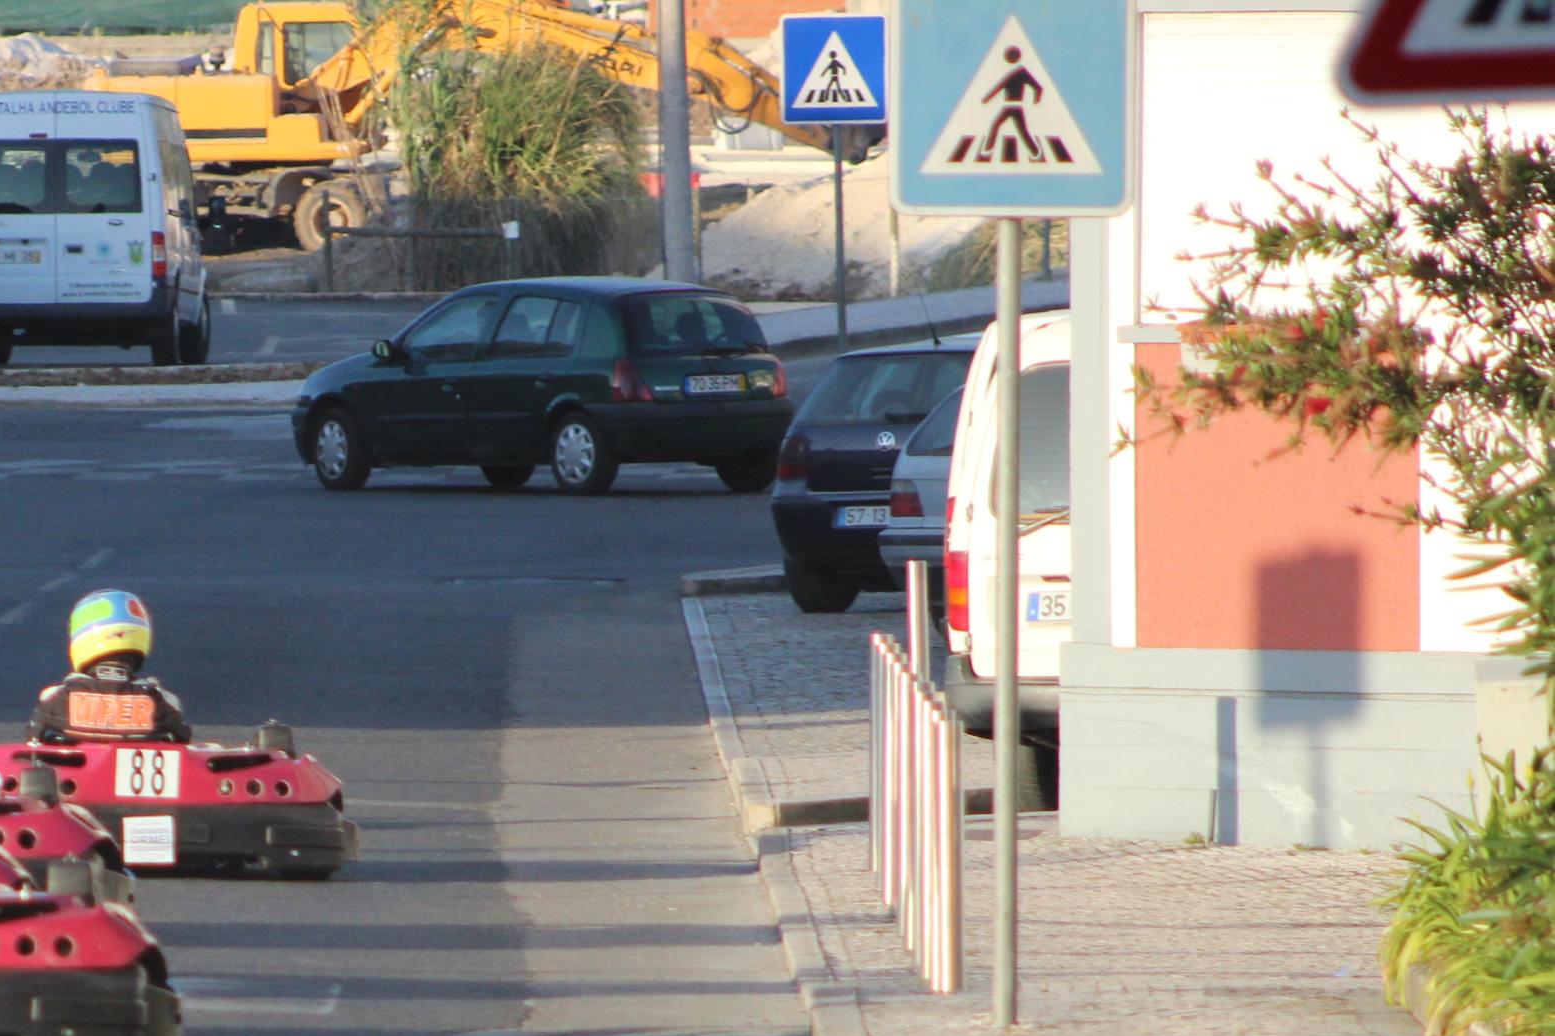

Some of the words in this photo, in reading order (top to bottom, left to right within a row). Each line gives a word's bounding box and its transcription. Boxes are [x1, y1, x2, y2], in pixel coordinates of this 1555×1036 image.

[39, 100, 94, 114] ANDEBOL
[97, 99, 136, 113] CLUBE
[1040, 594, 1066, 617] 35
[69, 692, 154, 731] VIPER
[130, 749, 166, 796] 88
